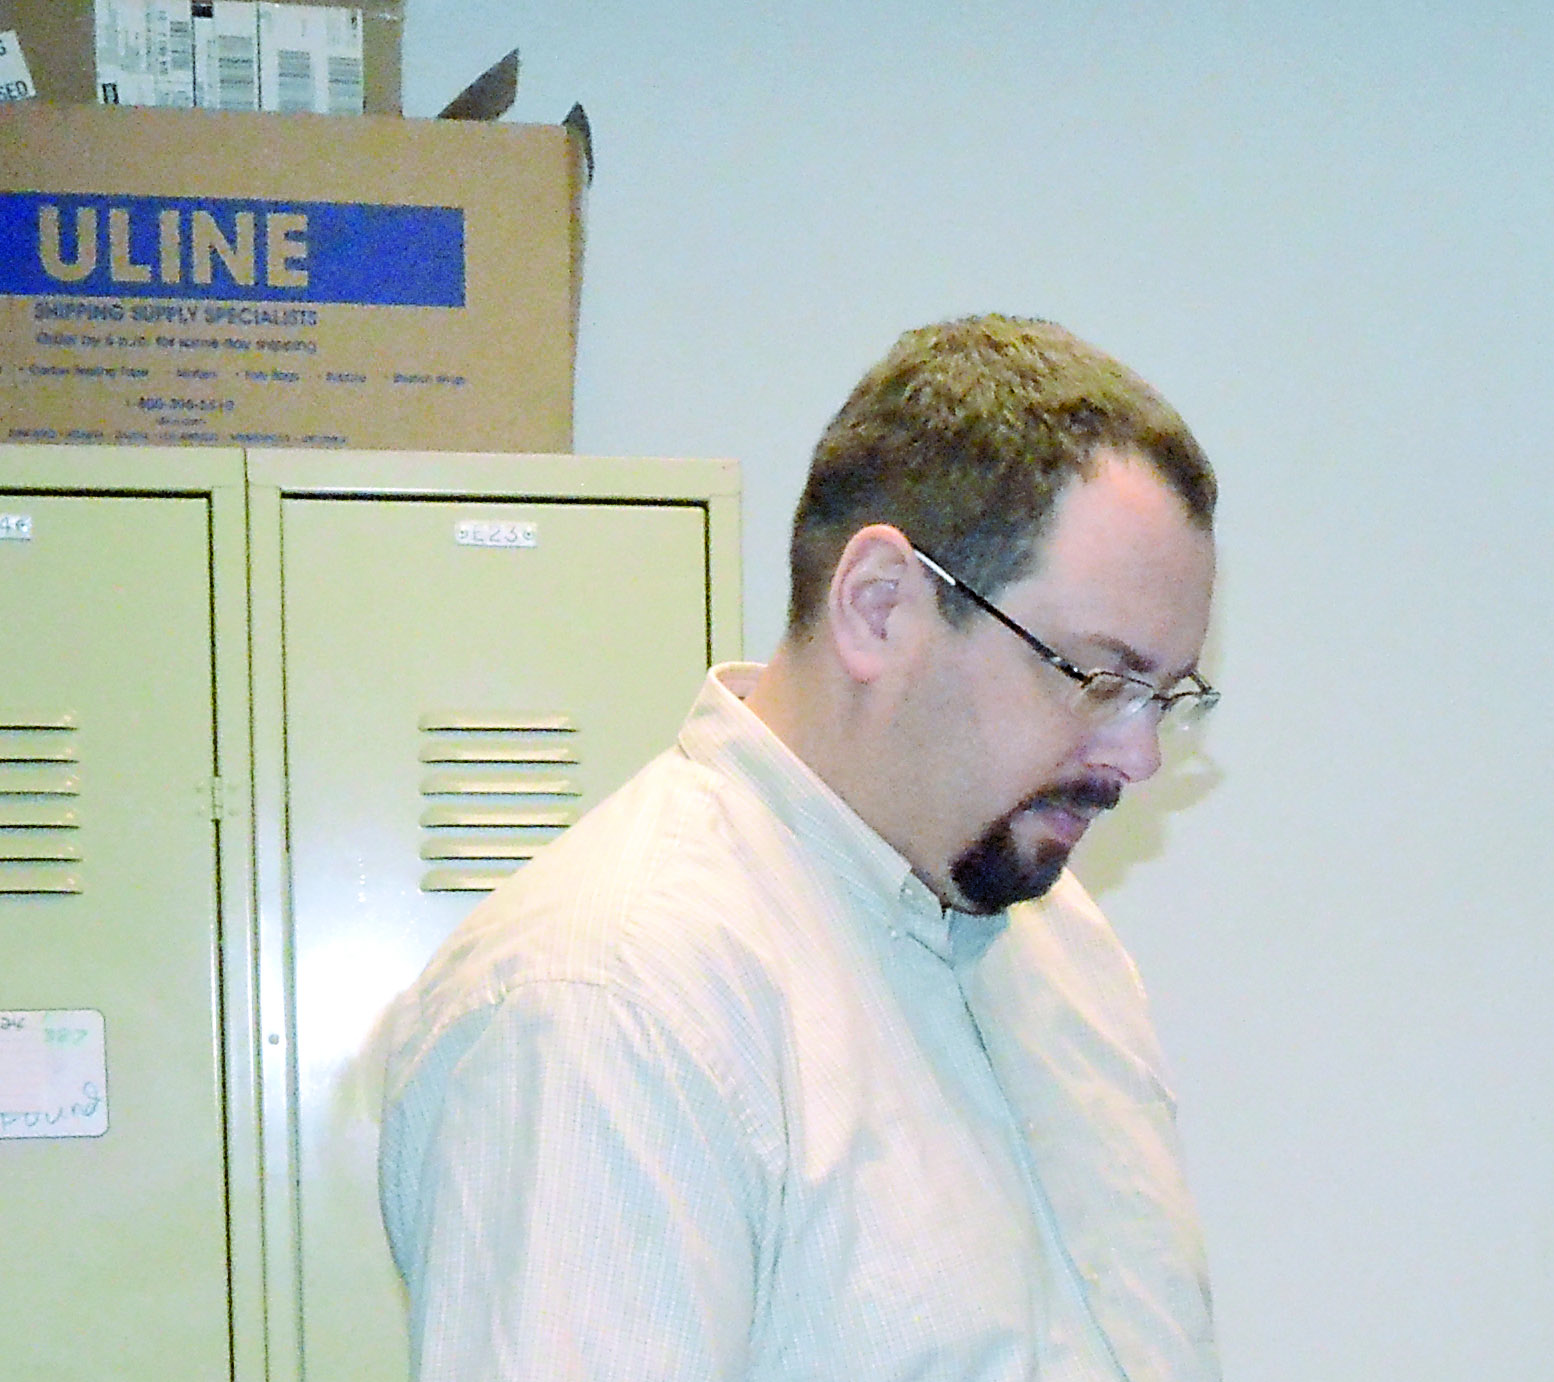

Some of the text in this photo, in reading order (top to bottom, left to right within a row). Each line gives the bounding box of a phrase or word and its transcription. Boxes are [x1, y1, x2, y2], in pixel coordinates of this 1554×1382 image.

[39, 206, 309, 288] ULINE
[34, 301, 318, 326] SHIPPING SUPPLY SPECIALISTS
